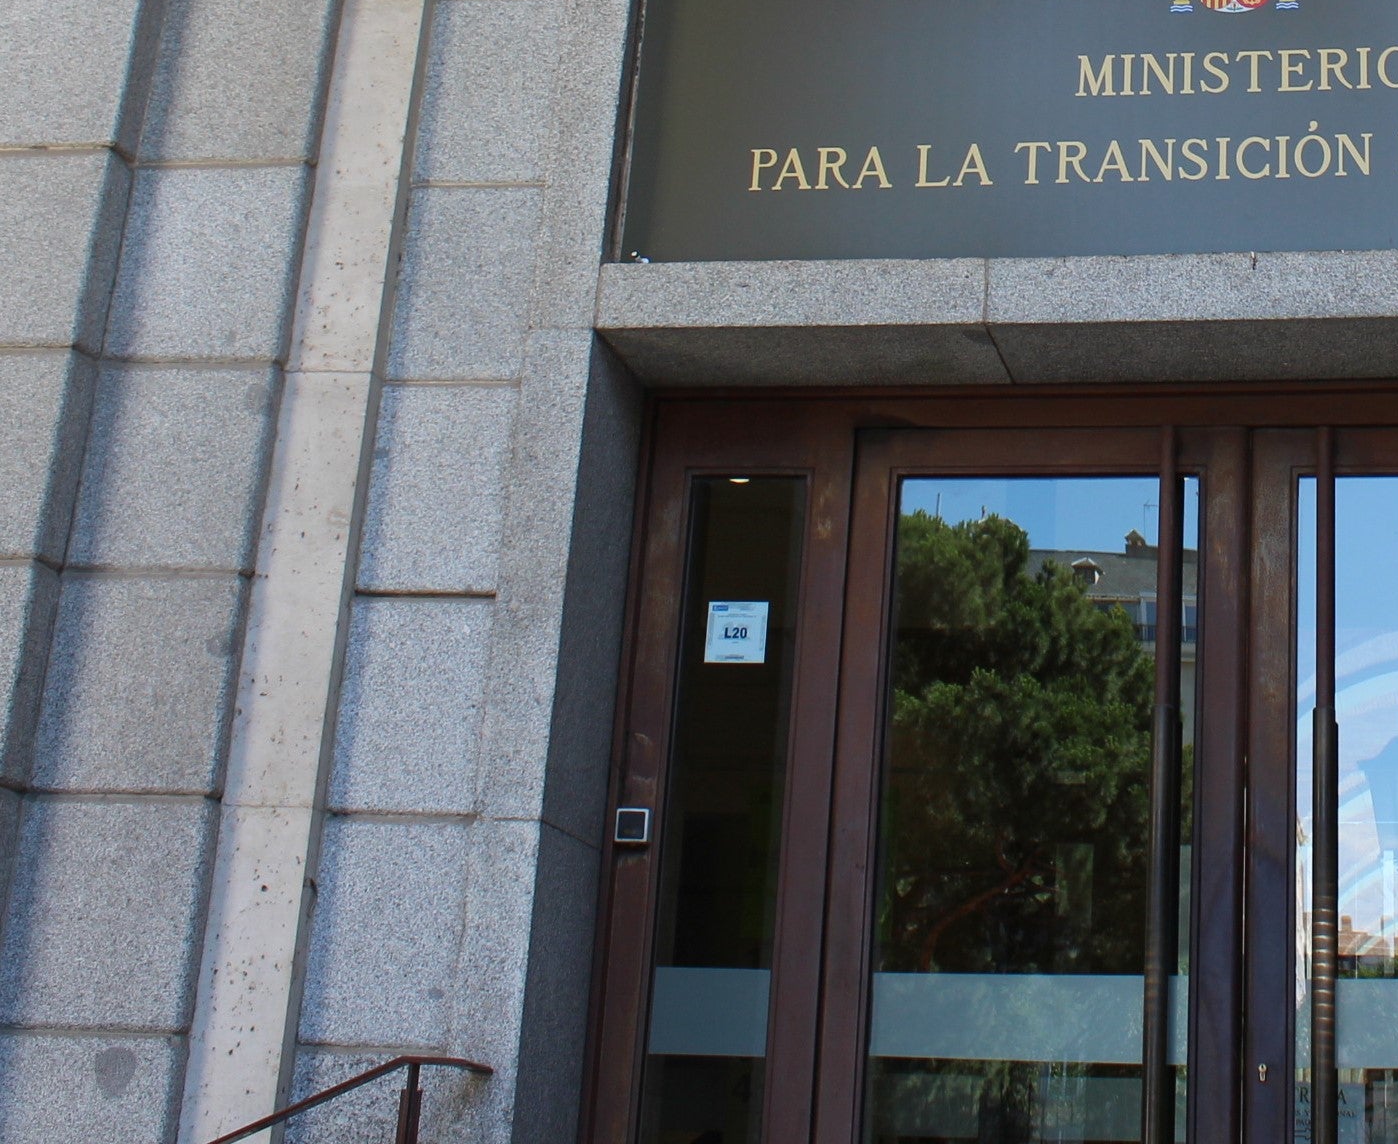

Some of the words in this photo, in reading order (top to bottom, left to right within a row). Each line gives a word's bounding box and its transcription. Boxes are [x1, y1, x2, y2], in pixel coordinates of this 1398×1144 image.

[748, 146, 893, 191] PARA
[915, 144, 993, 187] LA
[1014, 120, 1373, 185] TRANSICIÓN
[724, 627, 748, 639] L20
